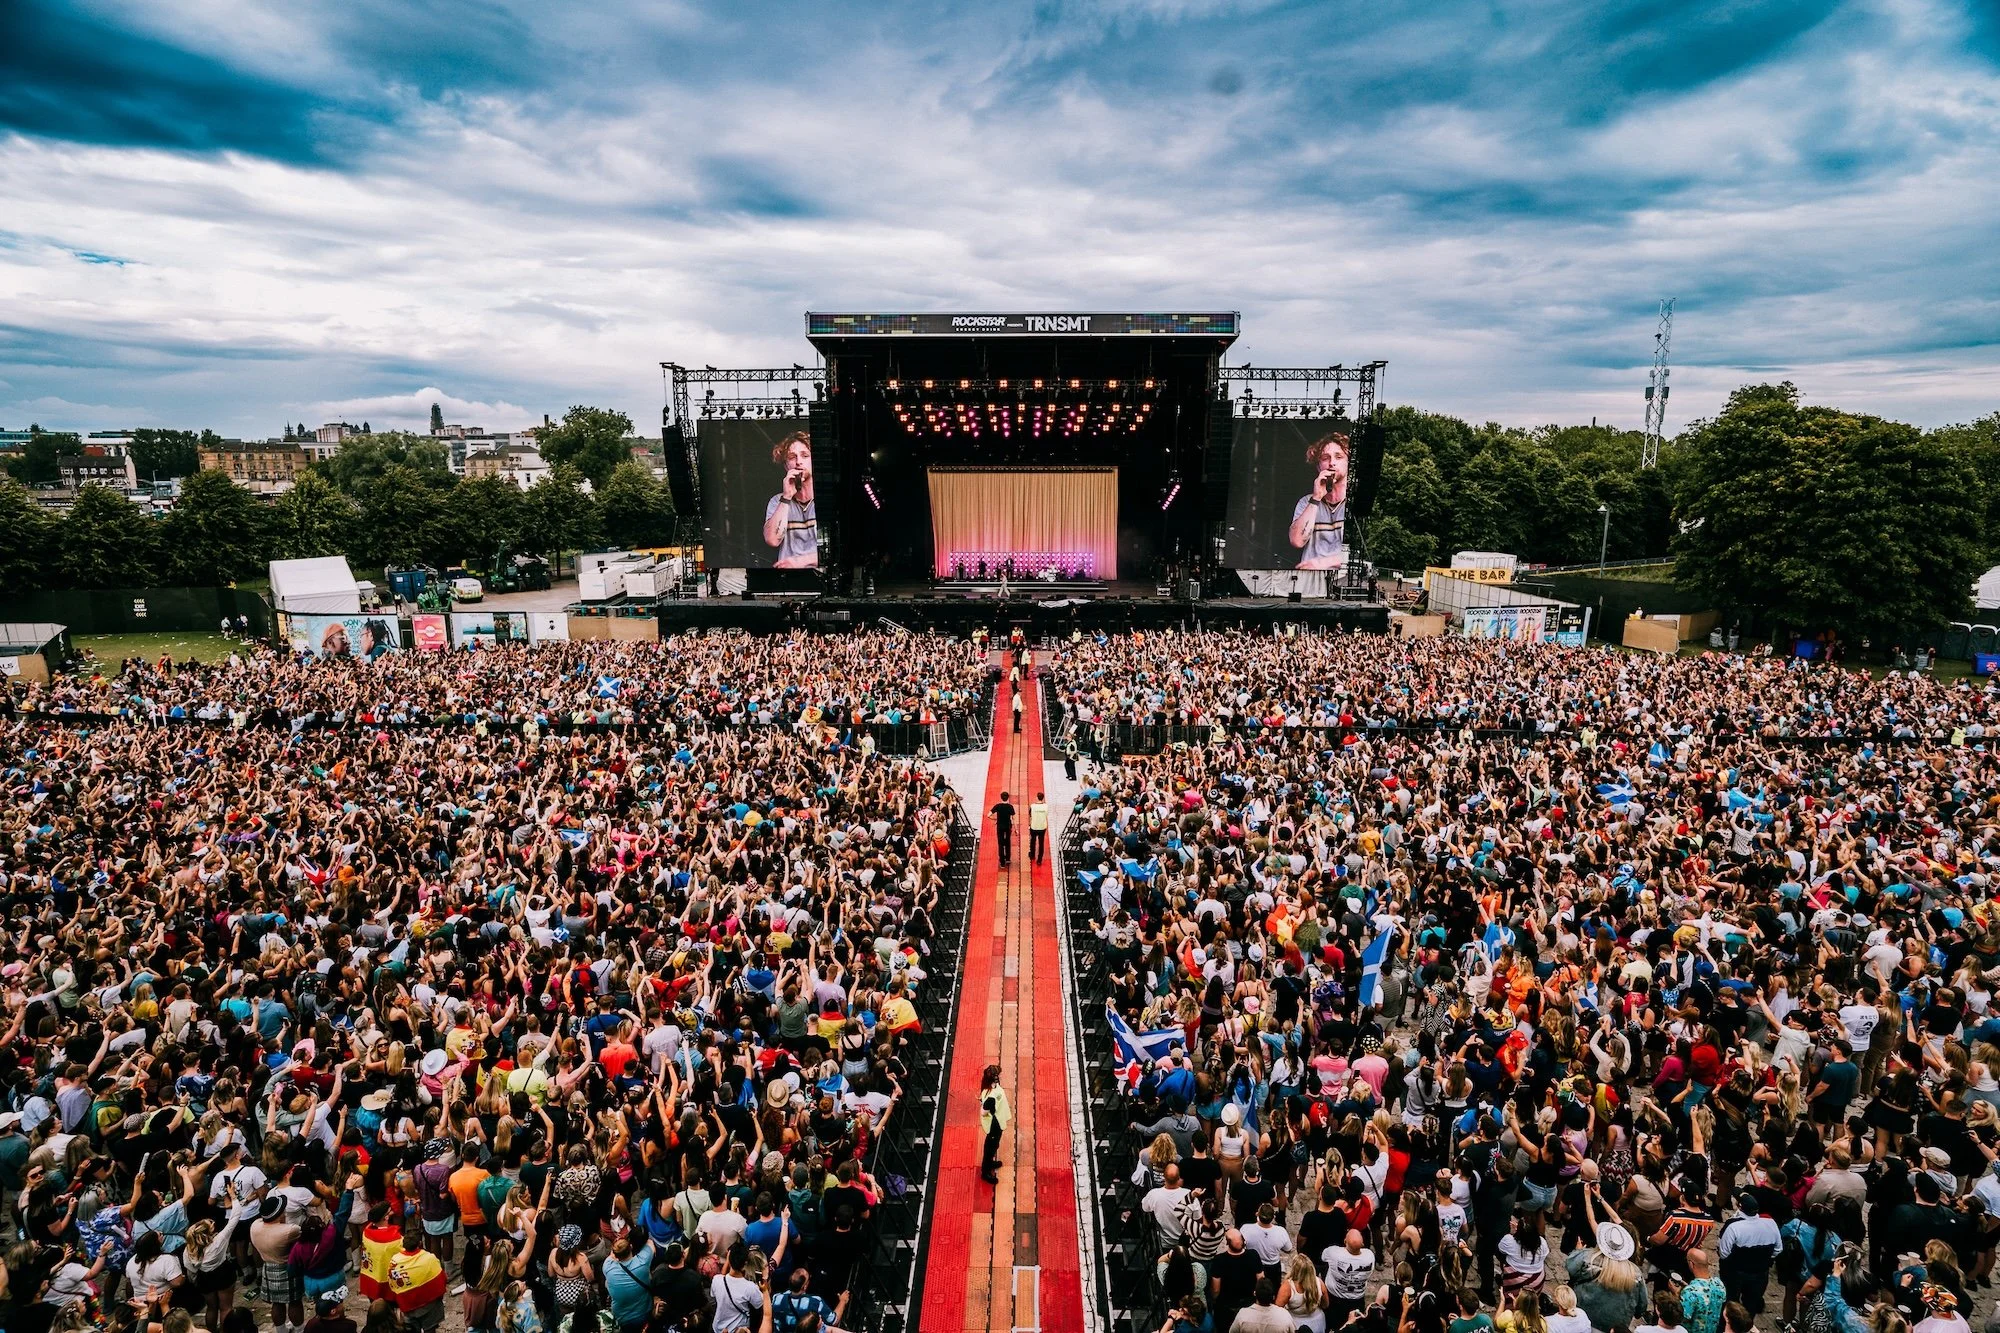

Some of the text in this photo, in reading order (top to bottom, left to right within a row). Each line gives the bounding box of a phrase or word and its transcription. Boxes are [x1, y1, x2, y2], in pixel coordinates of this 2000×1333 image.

[952, 316, 1006, 327] ROCKSTAR
[1025, 316, 1091, 331] TRNSMT
[1450, 569, 1506, 580] THE BAR
